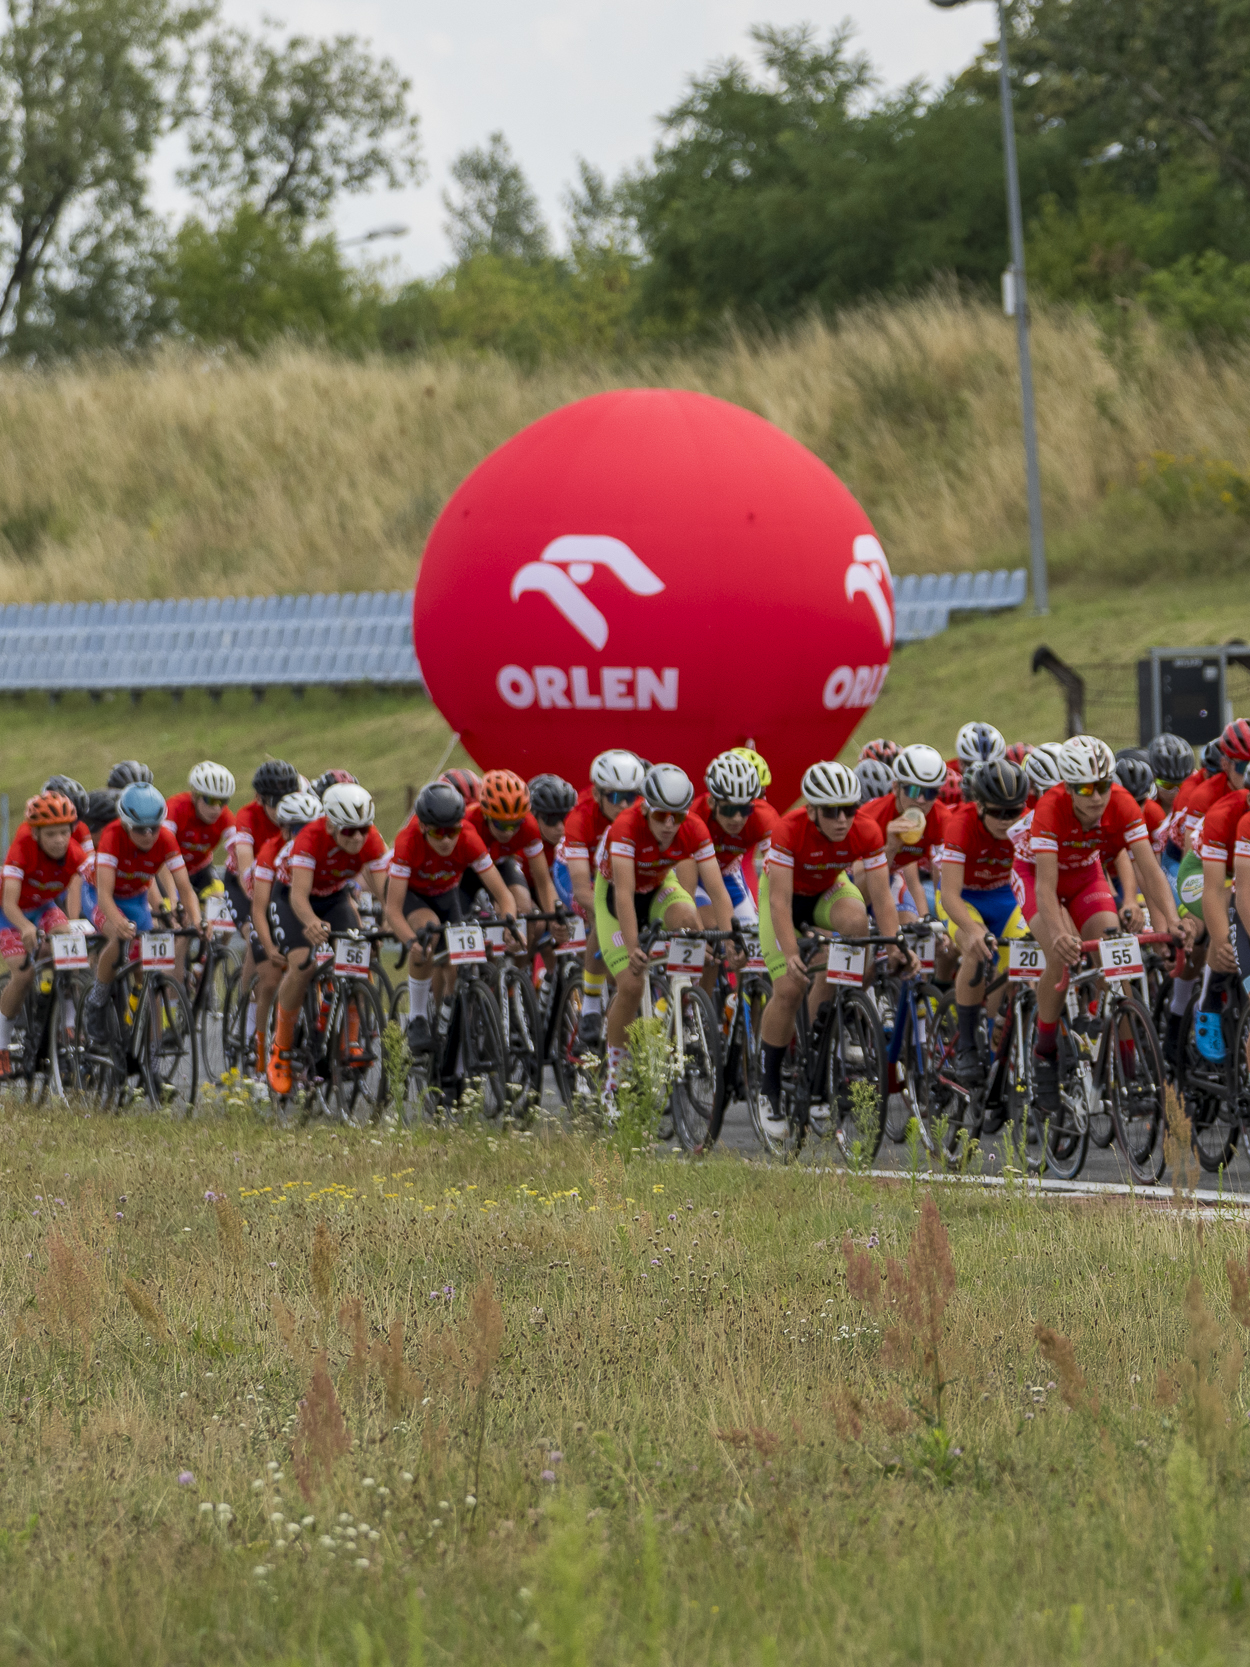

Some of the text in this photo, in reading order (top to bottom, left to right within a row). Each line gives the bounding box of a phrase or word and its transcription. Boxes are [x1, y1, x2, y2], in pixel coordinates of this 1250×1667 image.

[496, 664, 679, 711] ORLEN
[63, 943, 78, 956] 14
[151, 943, 167, 957] 10
[458, 935, 476, 950] 19
[346, 949, 363, 965] 56
[682, 949, 692, 964] 2
[844, 955, 852, 971] 1
[1020, 951, 1038, 967] 20
[1112, 949, 1132, 966] 55
